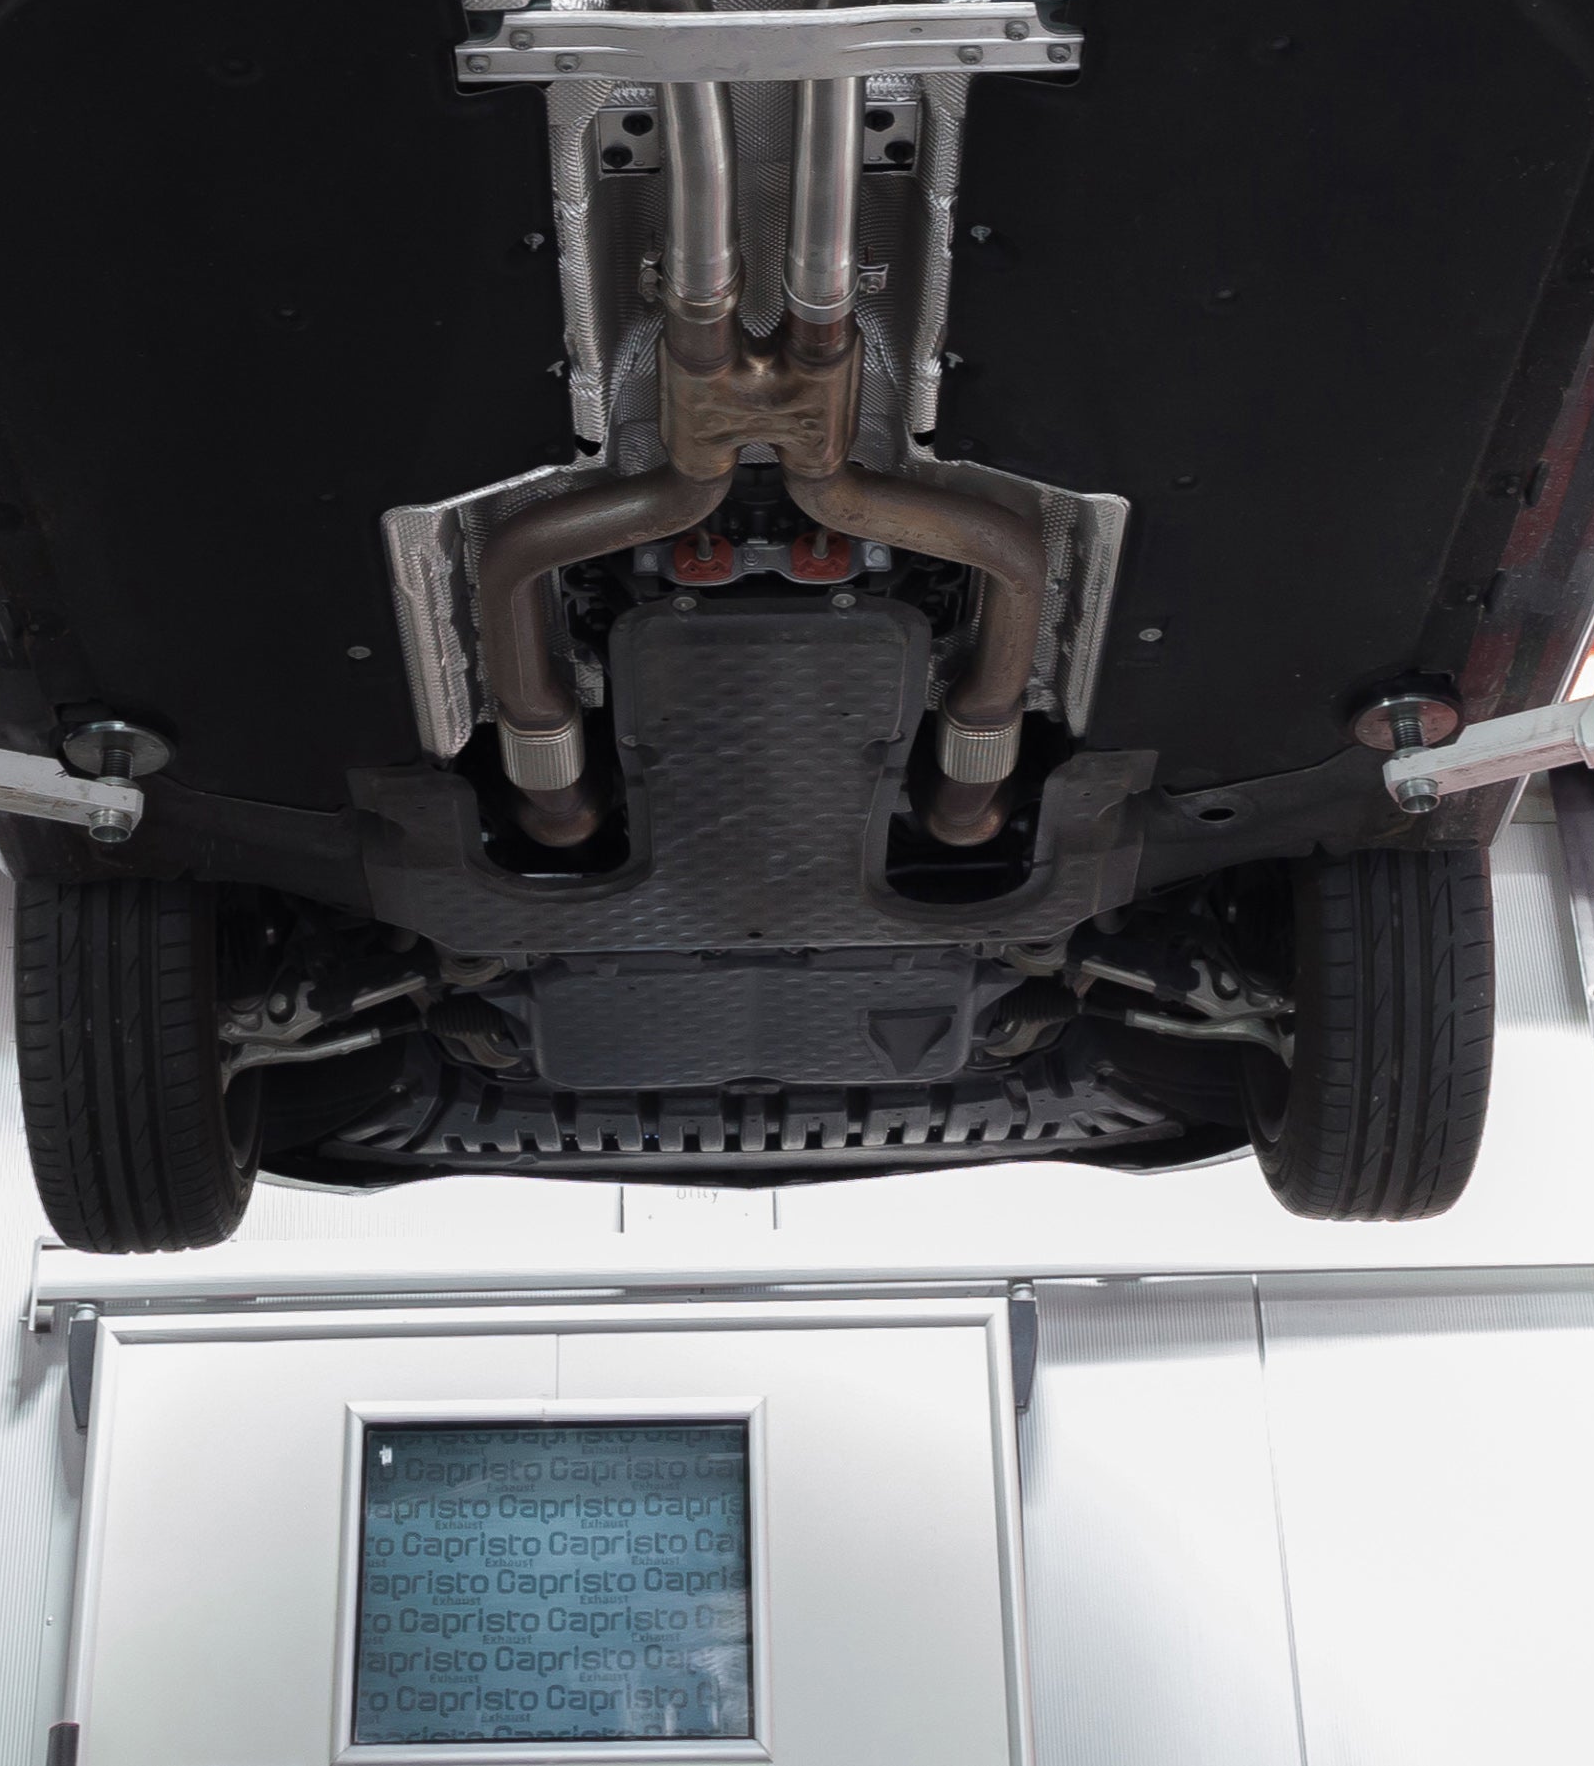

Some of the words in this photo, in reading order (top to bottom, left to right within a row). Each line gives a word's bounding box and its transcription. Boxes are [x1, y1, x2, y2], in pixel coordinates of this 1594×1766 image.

[404, 1456, 543, 1488] Capristo
[549, 1455, 688, 1487] Capristo
[368, 1495, 491, 1525] apristo
[498, 1493, 637, 1525] Capristo
[434, 1520, 484, 1530] Exhaust
[580, 1519, 629, 1529] Exhaust
[401, 1531, 542, 1563] Capristo
[548, 1529, 688, 1562] Capristo
[485, 1557, 534, 1568] Exhaust
[630, 1555, 680, 1566] Exhaust
[367, 1570, 489, 1601] apristo
[496, 1568, 637, 1600] Capristo
[432, 1595, 482, 1606] Exhaust
[579, 1594, 629, 1605] Exhaust
[399, 1607, 540, 1640] Capristo
[547, 1605, 688, 1639] Capristo
[482, 1634, 533, 1645] Exhaust
[364, 1646, 488, 1679] apristo
[494, 1643, 637, 1678] Capristo
[429, 1673, 480, 1684] Exhaust
[579, 1672, 629, 1683] Exhaust
[396, 1685, 539, 1718] Capristo
[546, 1684, 688, 1717] Capristo
[480, 1713, 531, 1723] Exhaust
